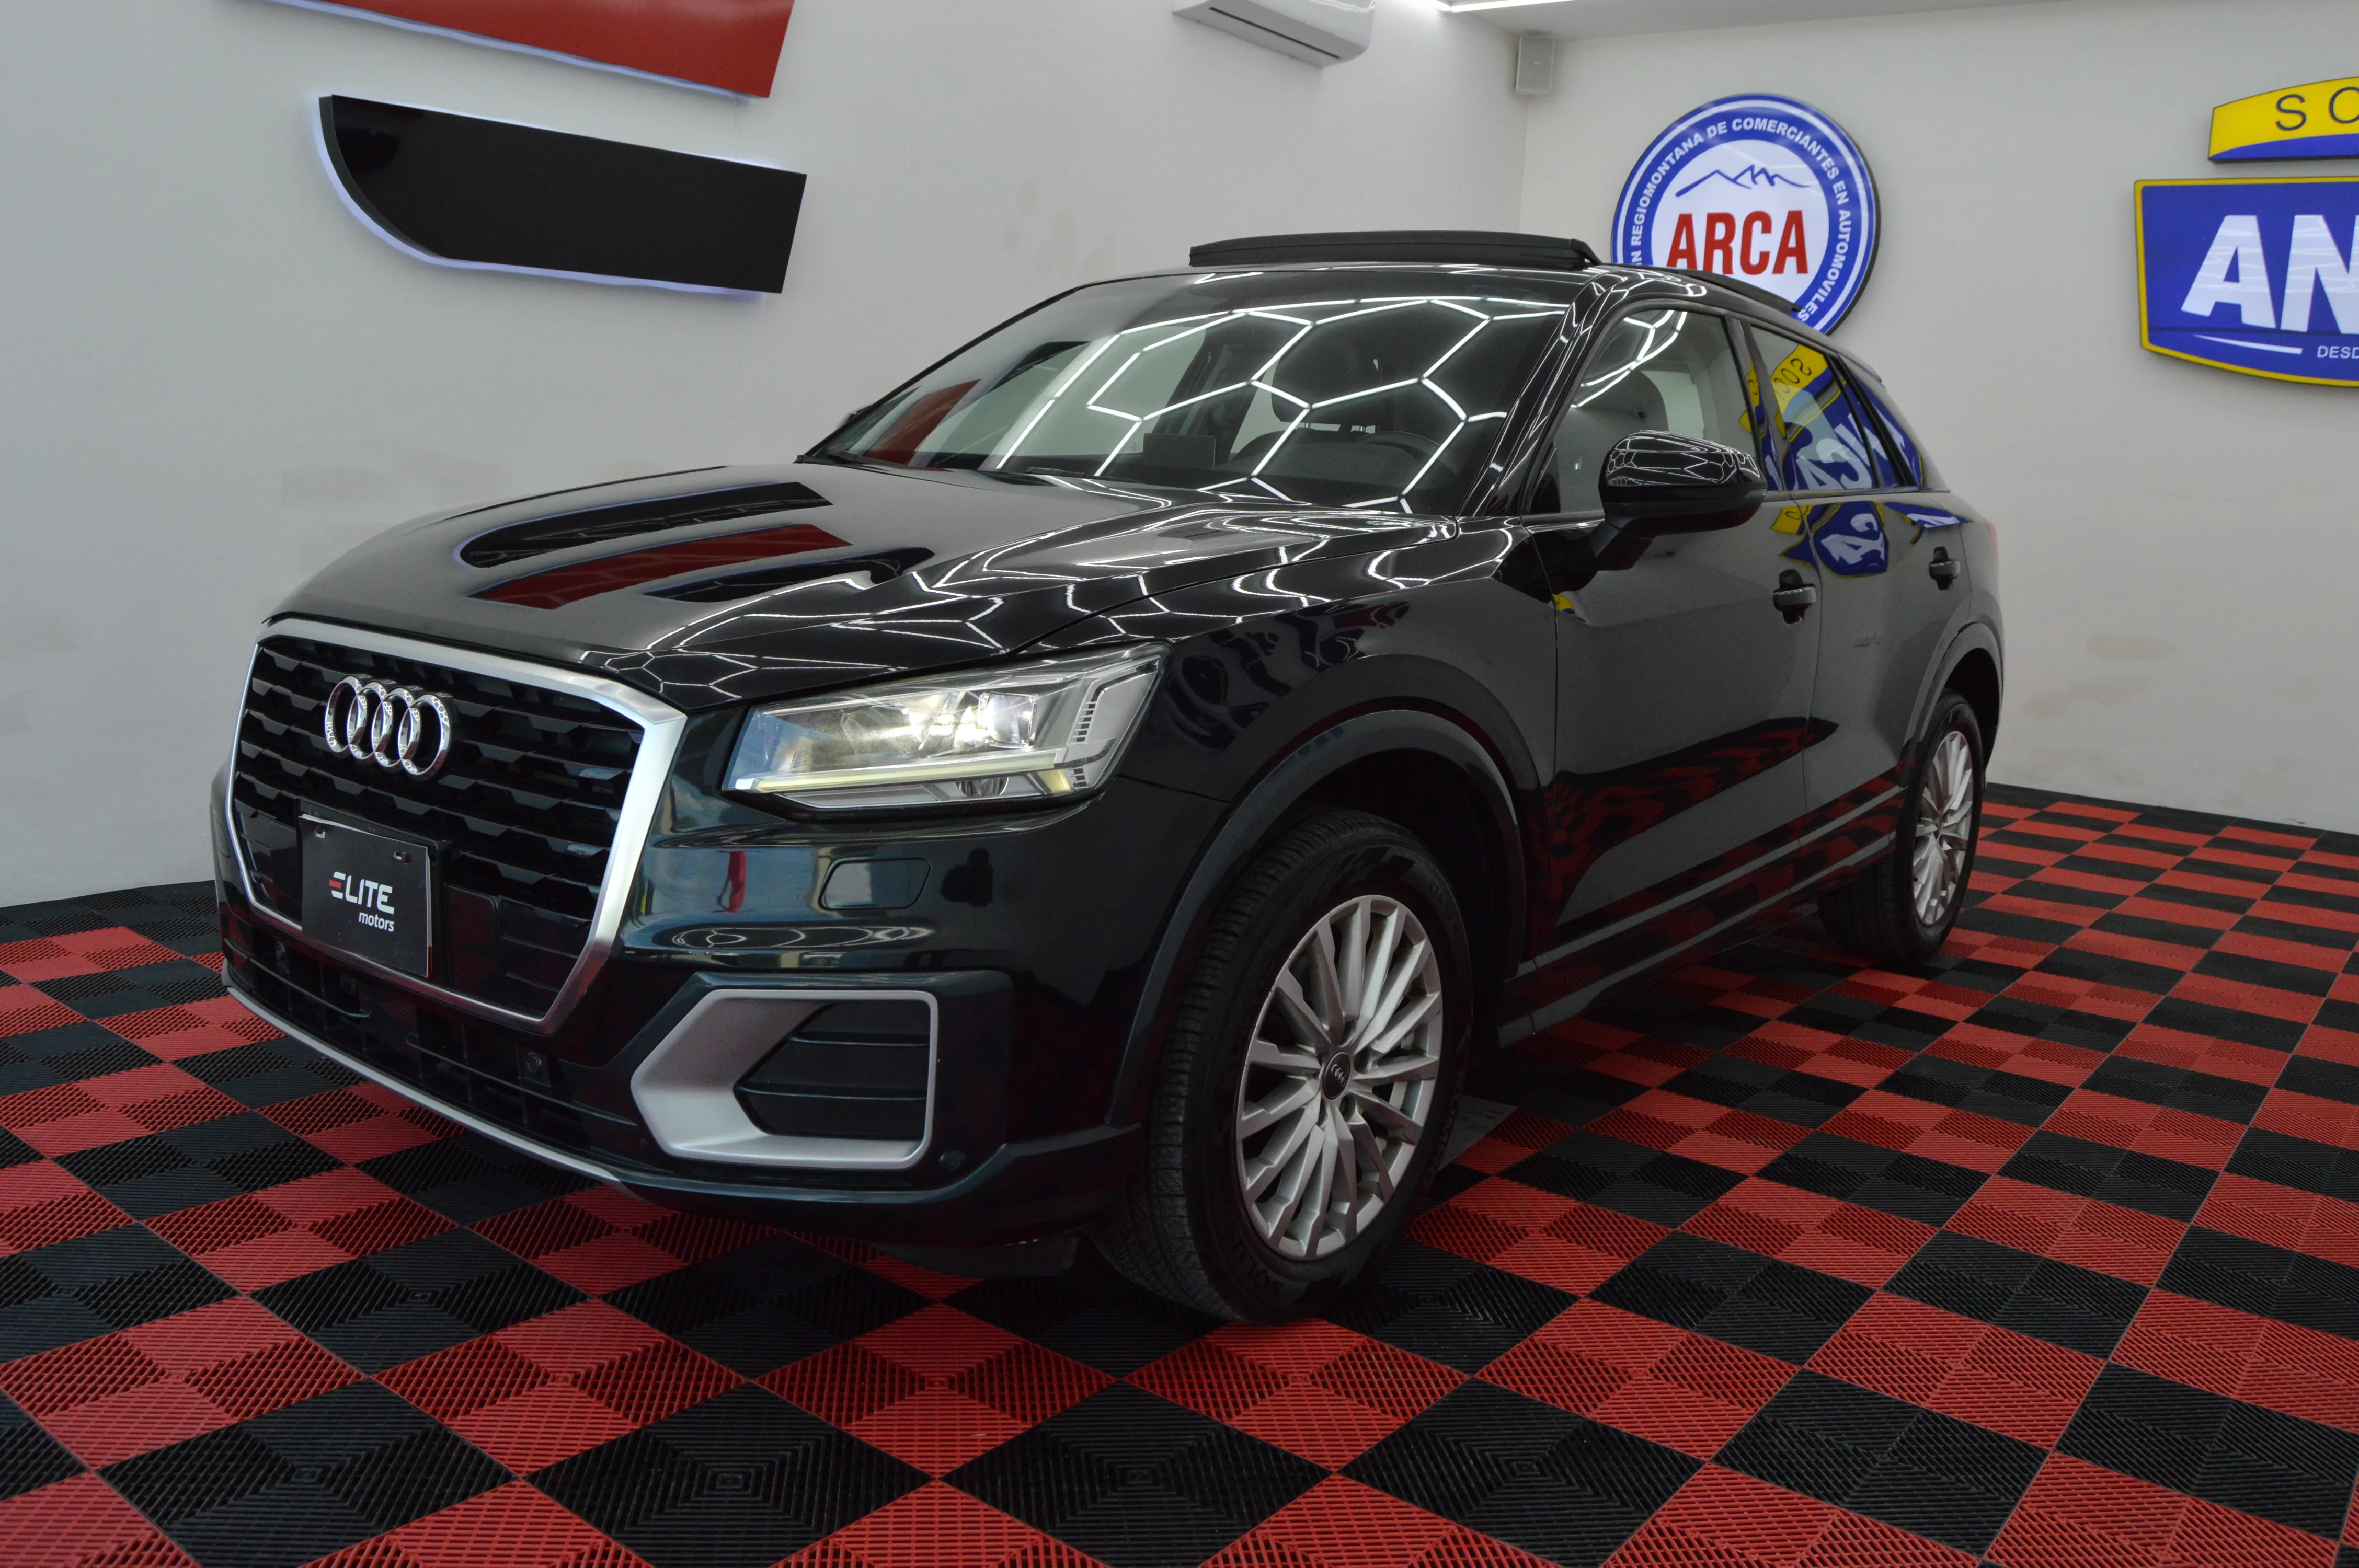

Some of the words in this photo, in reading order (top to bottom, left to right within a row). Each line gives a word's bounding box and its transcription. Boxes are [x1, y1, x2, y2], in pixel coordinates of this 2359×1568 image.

[1707, 120, 1728, 137] DE
[1732, 117, 1839, 180] COMERCIANTES
[1631, 133, 1704, 246] REGIOMONTANA
[1833, 180, 1849, 205] EN
[1666, 210, 1808, 275] ARCA
[1797, 209, 1852, 321] AUTOMOVILES
[329, 871, 395, 915] ELITE
[358, 912, 394, 932] motors
